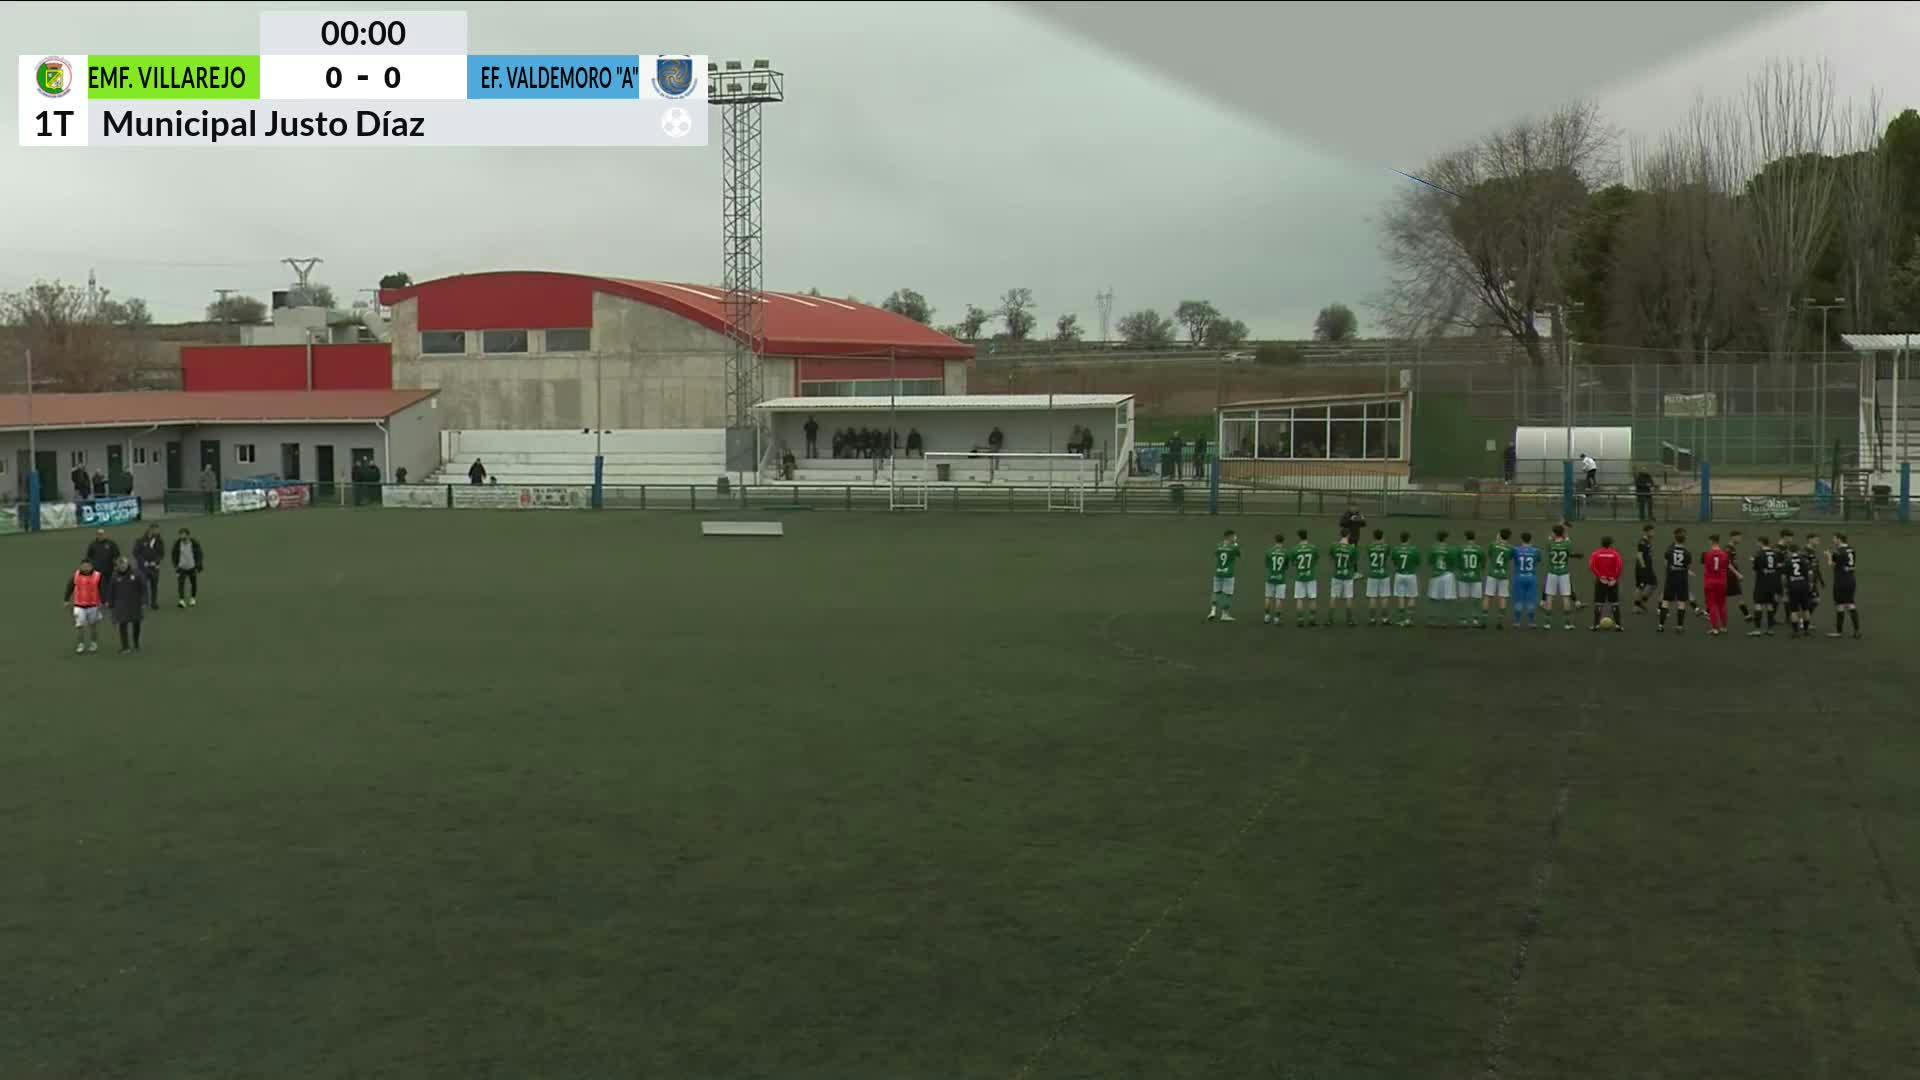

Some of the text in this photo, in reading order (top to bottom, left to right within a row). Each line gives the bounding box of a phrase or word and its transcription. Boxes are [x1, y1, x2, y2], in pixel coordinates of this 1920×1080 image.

[1220, 553, 1228, 566] 9
[1271, 556, 1284, 571] 19
[1297, 554, 1312, 569] 27
[1370, 553, 1385, 567] 21
[1400, 554, 1408, 569] 7
[1463, 554, 1477, 569] 10
[1496, 552, 1504, 566] 4
[1519, 557, 1534, 571] 13
[1551, 551, 1567, 564] 22
[1672, 553, 1685, 566] 12
[1713, 556, 1719, 571] 1
[1792, 563, 1800, 576] 2
